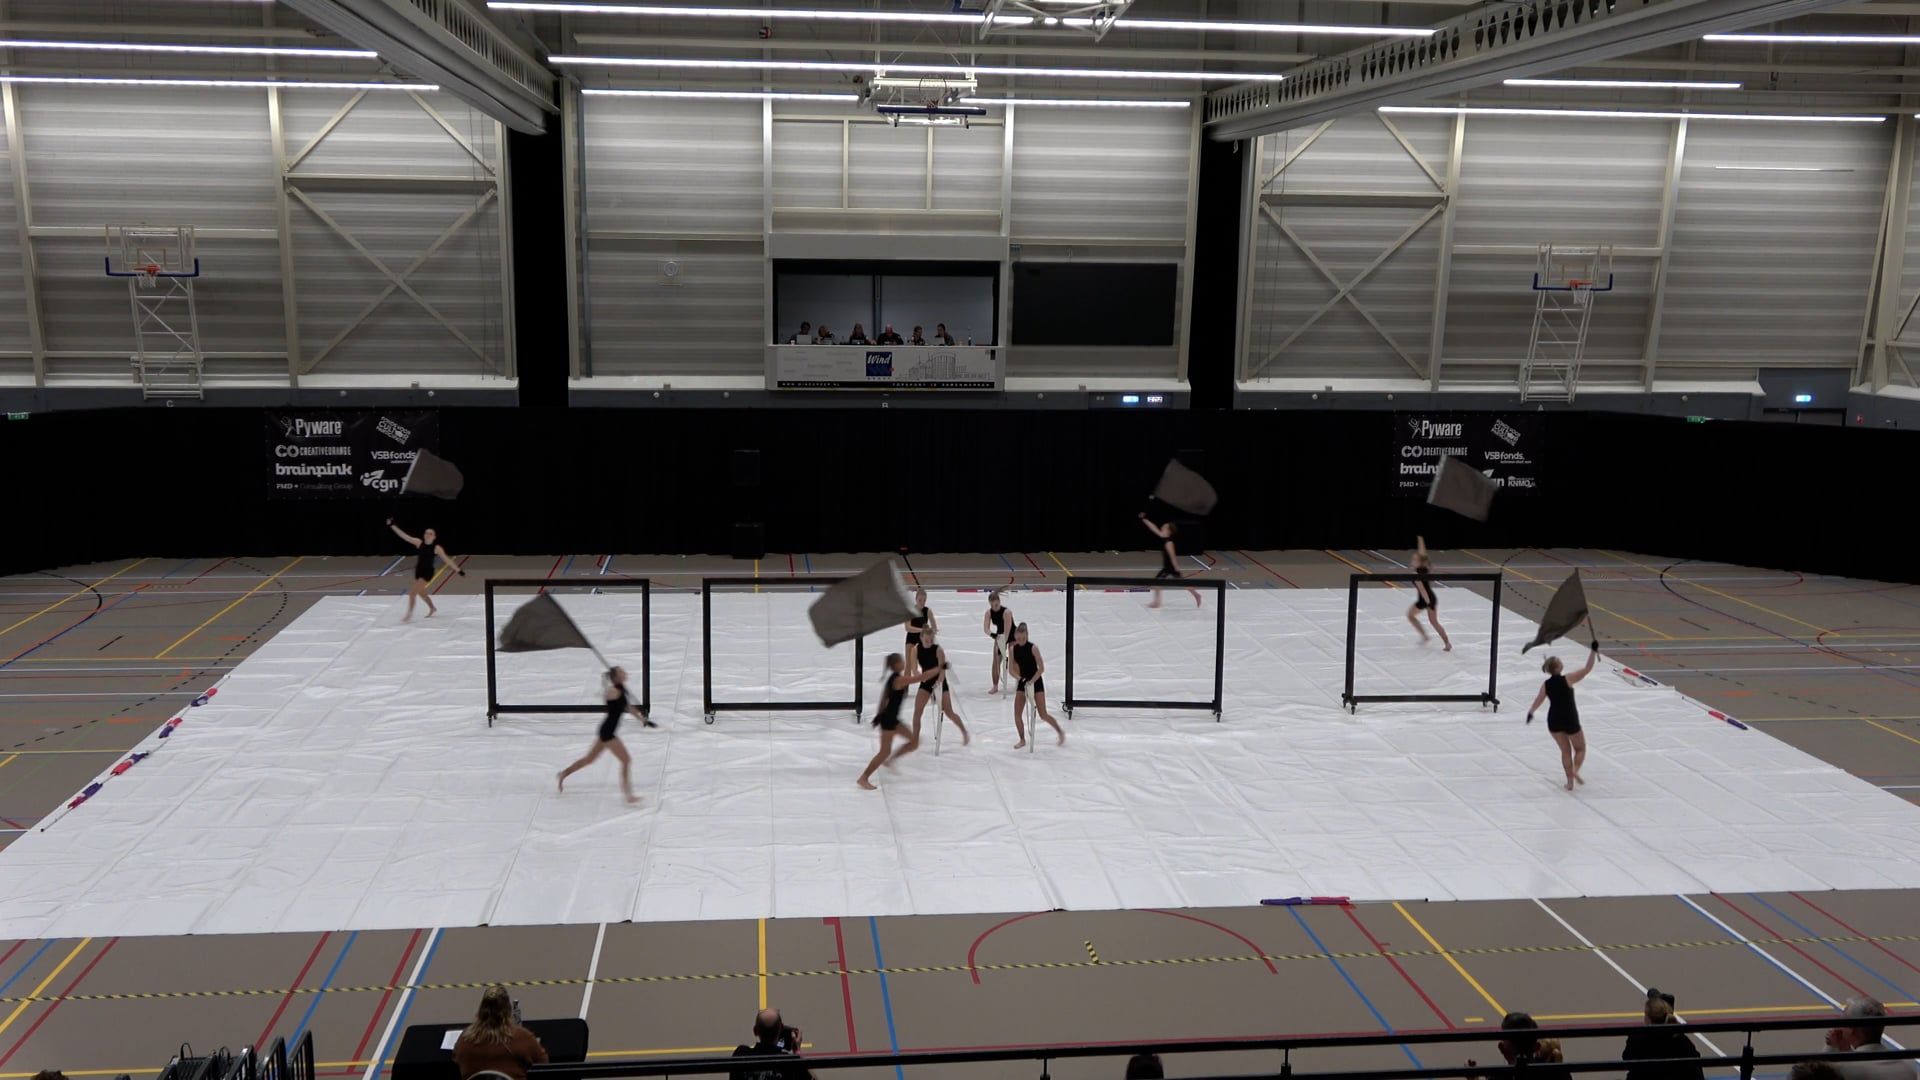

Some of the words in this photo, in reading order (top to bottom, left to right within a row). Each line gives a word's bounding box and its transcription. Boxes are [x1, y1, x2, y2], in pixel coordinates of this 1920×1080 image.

[867, 354, 891, 365] Wind
[295, 418, 342, 438] Pyware
[1422, 420, 1462, 439] Pyware
[275, 463, 353, 478] brainpink
[1400, 462, 1441, 475] brain
[371, 478, 398, 492] cgn
